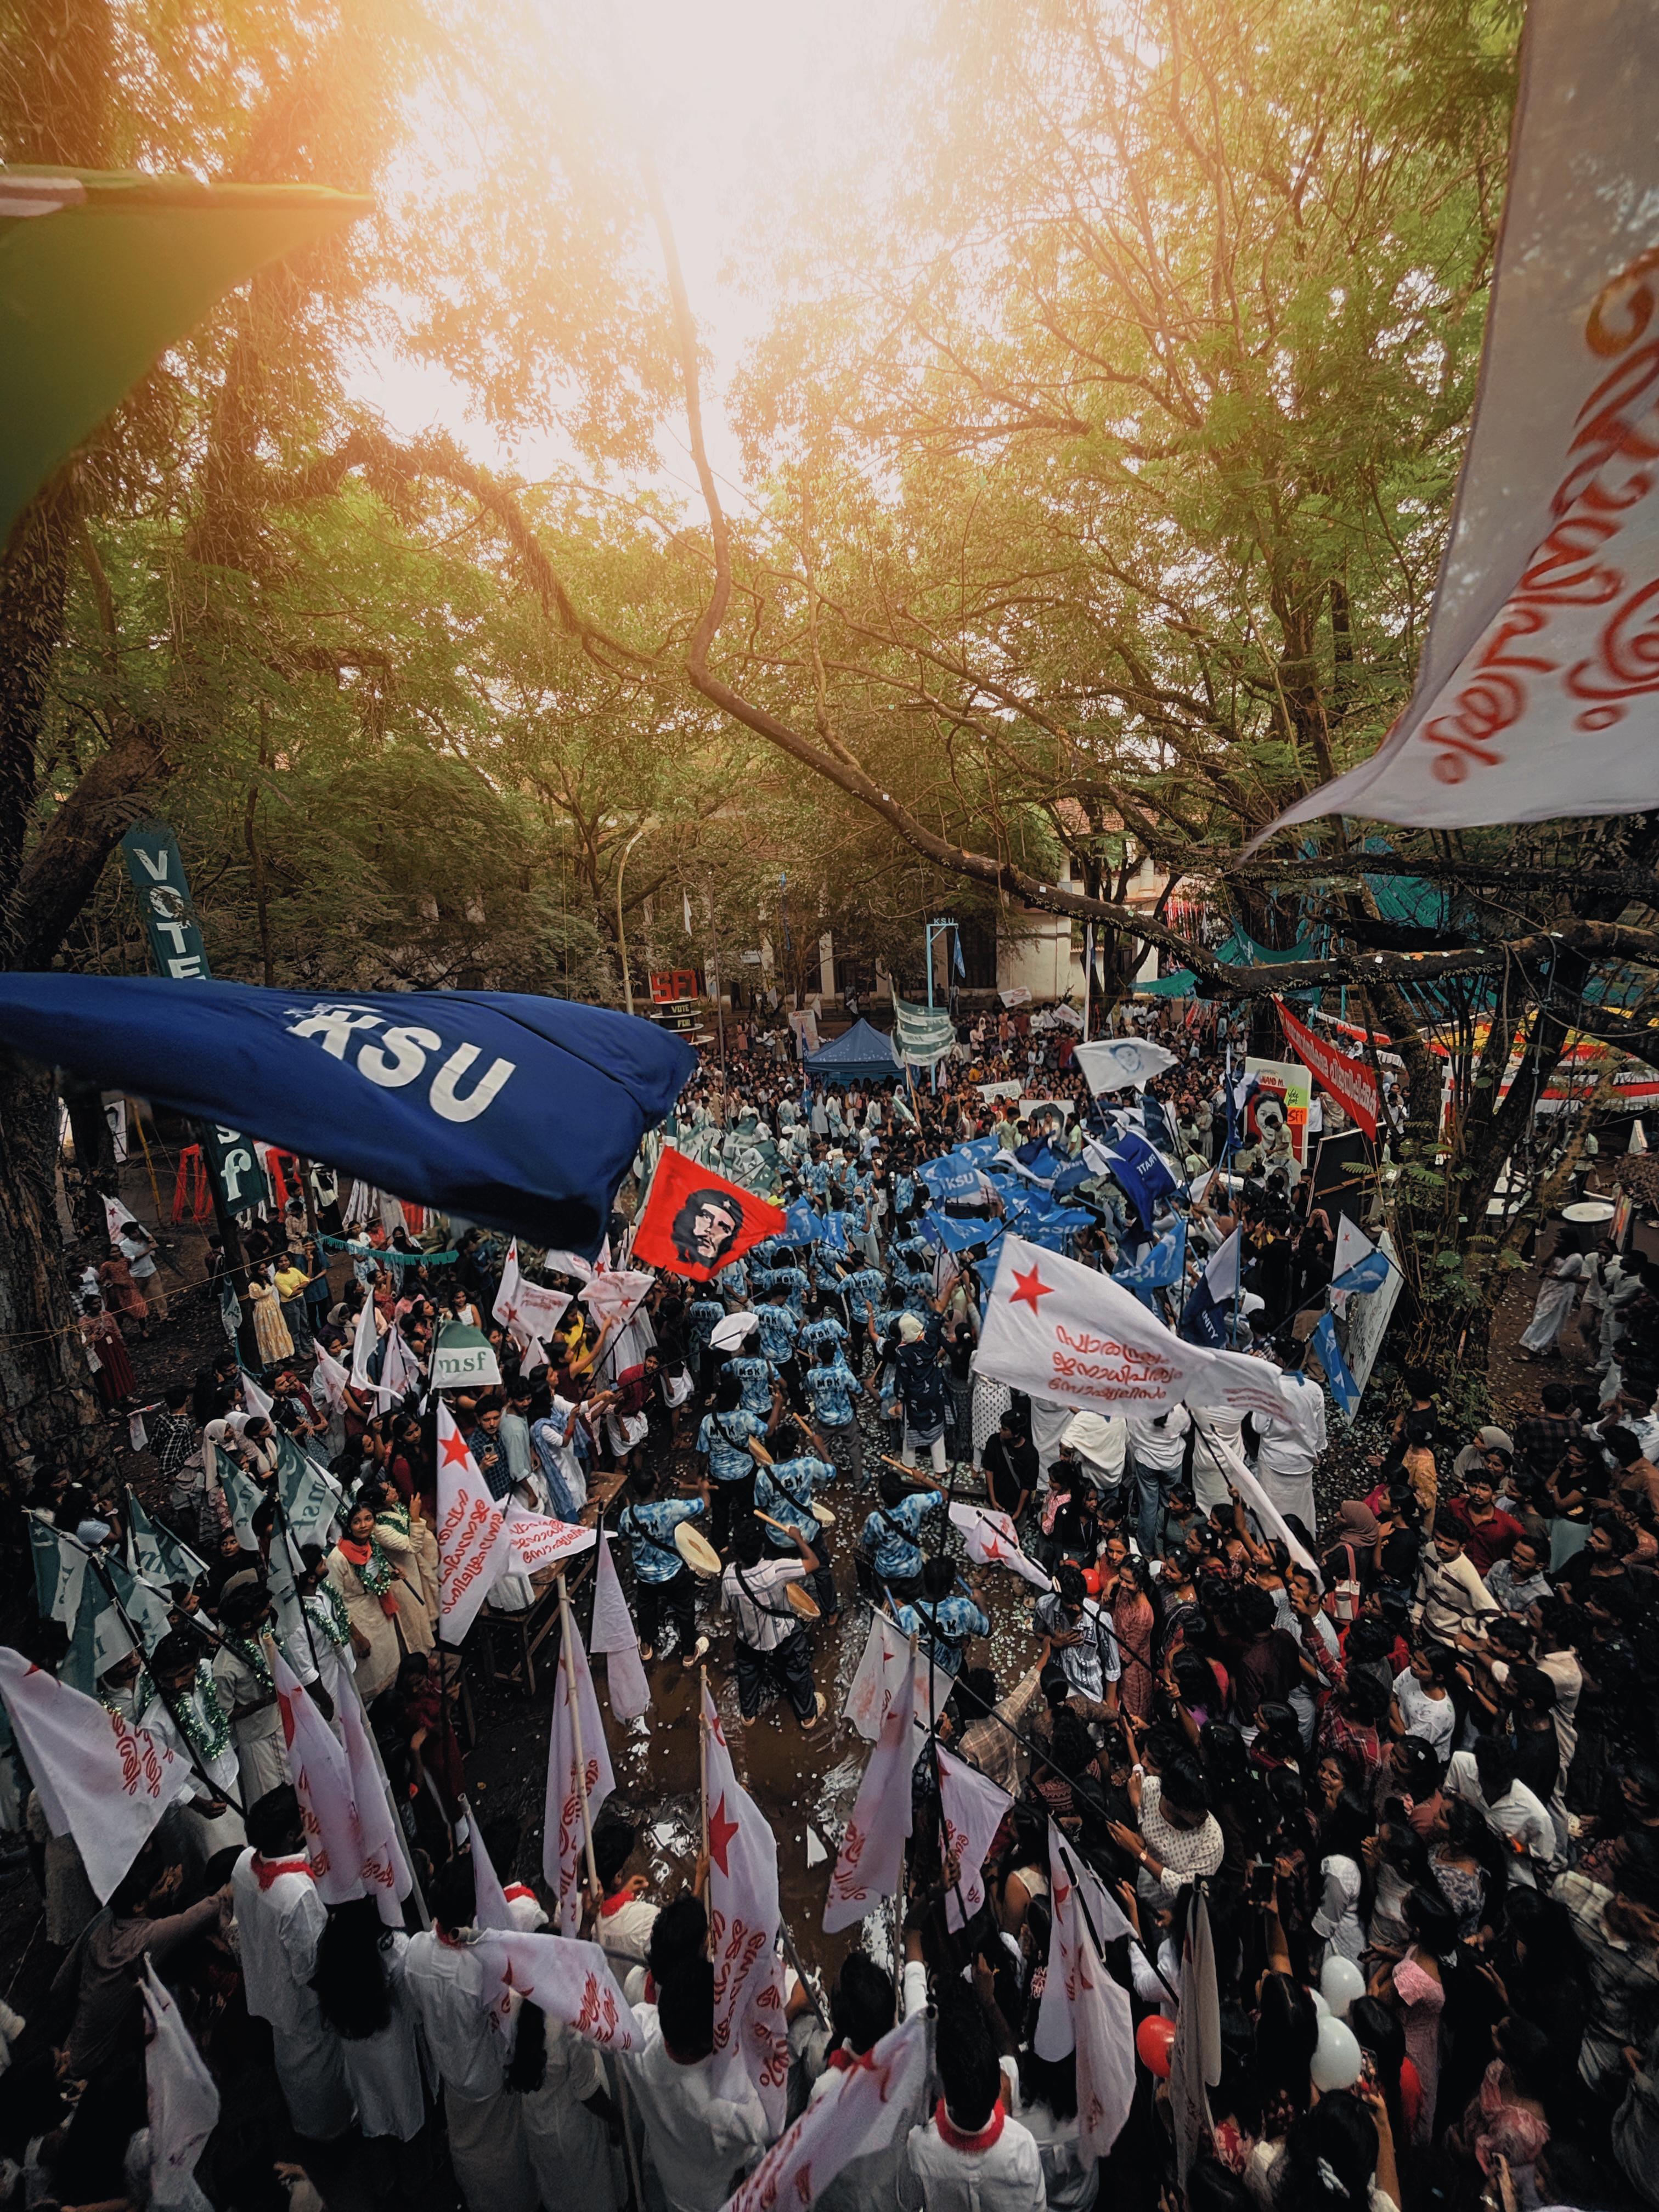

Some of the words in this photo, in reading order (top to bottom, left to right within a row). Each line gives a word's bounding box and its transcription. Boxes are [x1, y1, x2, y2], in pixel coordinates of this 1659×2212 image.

[133, 849, 207, 980] VOTE
[651, 969, 698, 1003] SFI
[670, 1004, 690, 1014] VOTE
[946, 1172, 974, 1190] KSU
[439, 1352, 487, 1375] msf
[709, 1425, 735, 1436] MK
